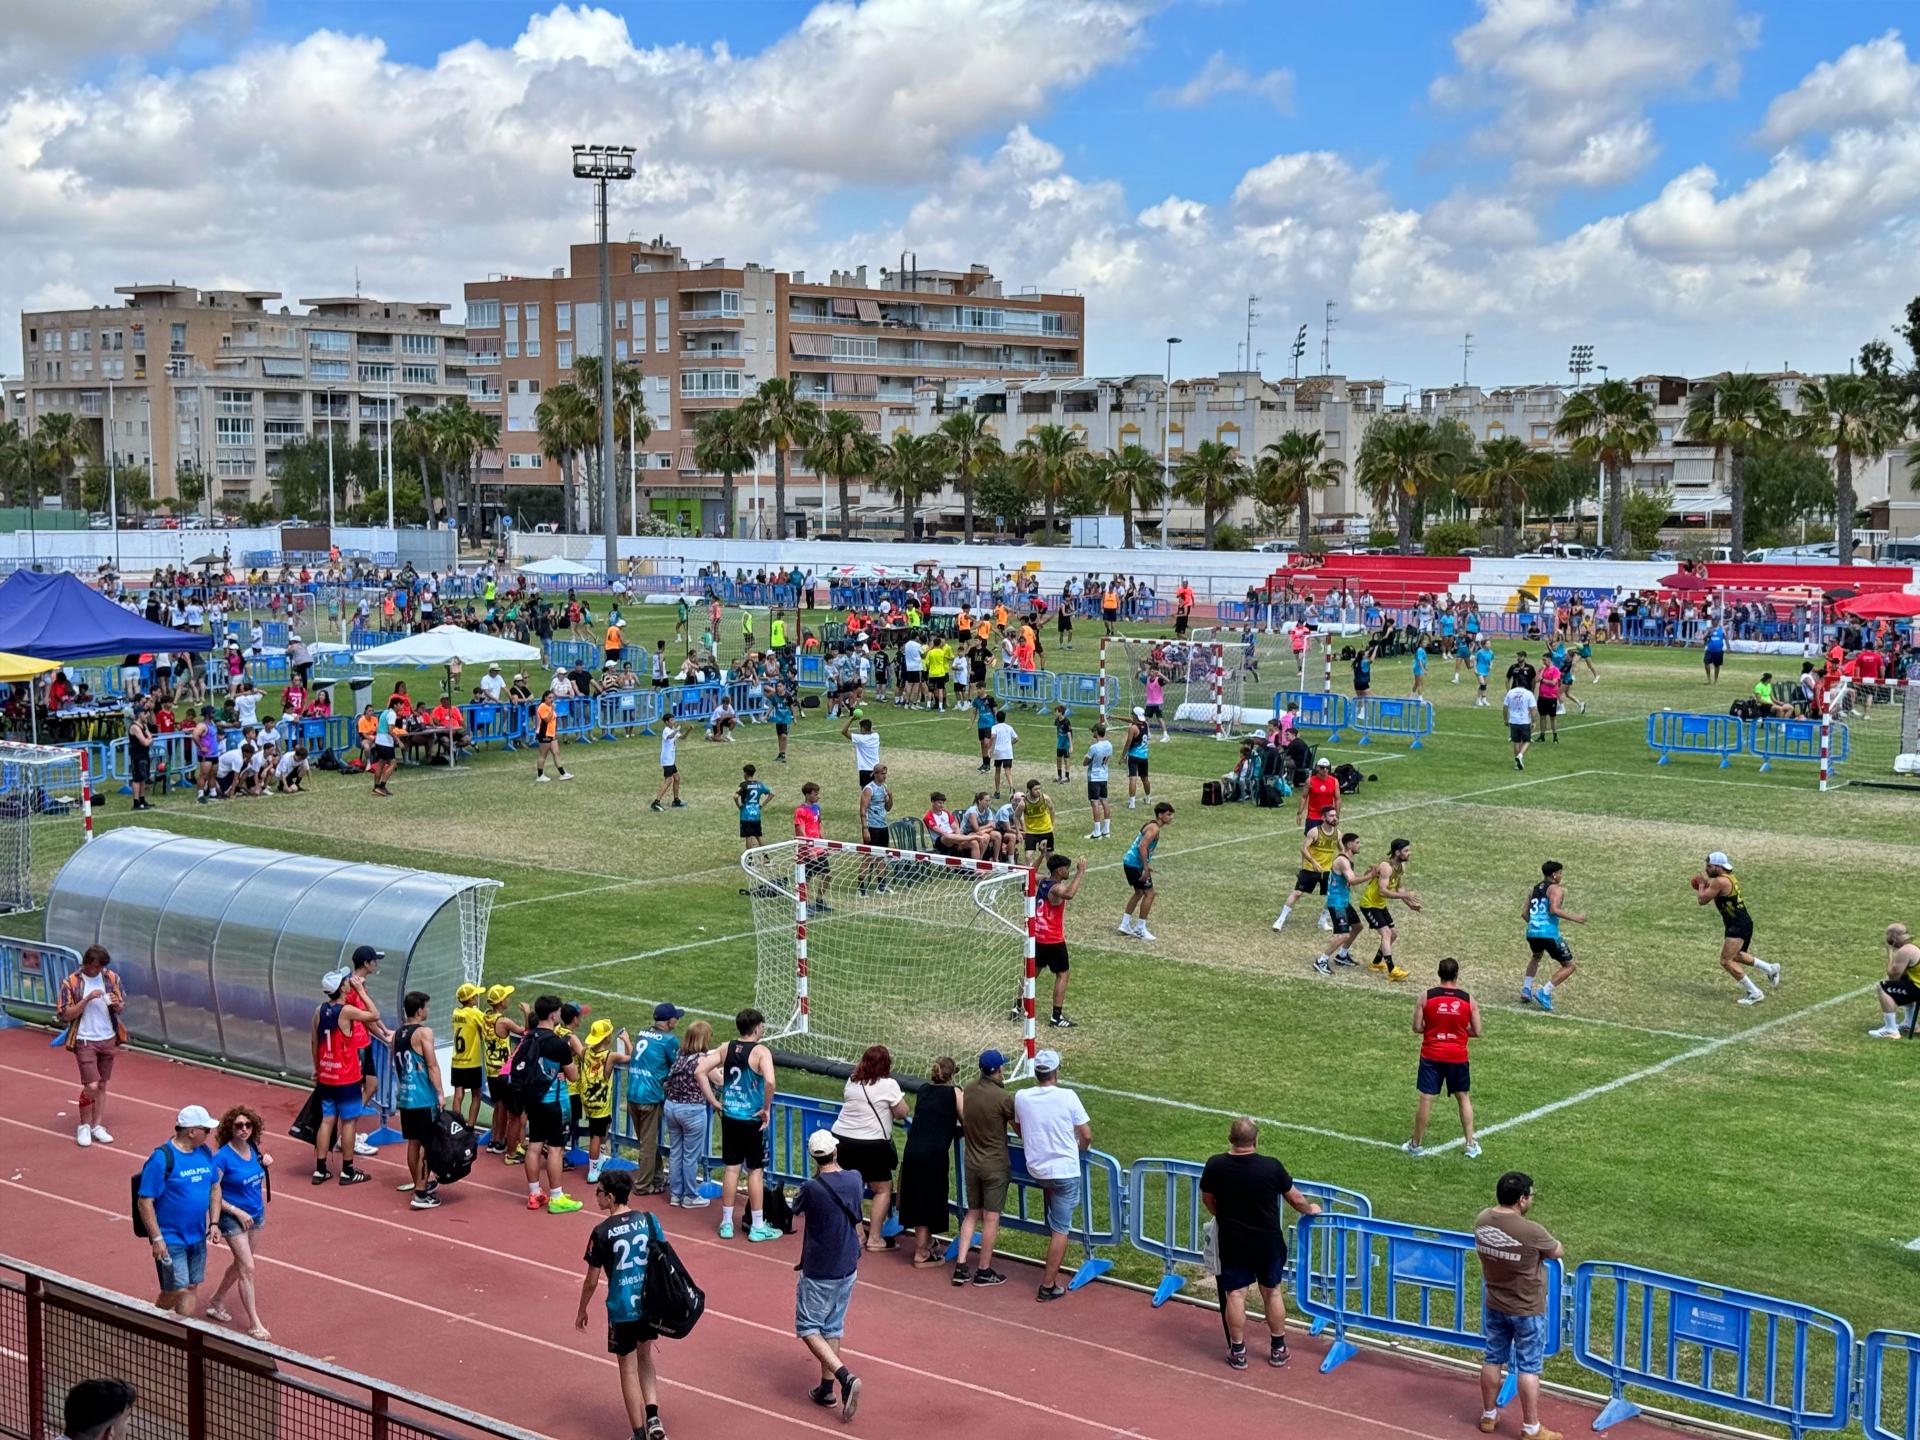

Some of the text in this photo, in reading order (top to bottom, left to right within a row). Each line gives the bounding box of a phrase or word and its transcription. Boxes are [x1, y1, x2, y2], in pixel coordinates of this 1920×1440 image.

[1547, 589, 1572, 600] SANTA
[748, 789, 758, 803] 2
[1529, 897, 1546, 915] 35
[323, 1029, 332, 1052] 1
[454, 1027, 466, 1054] 6
[635, 1039, 649, 1061] 9
[396, 1050, 413, 1074] 18
[729, 1066, 743, 1091] 2
[180, 1168, 197, 1178] SANTA
[607, 1223, 631, 1240] ASIER
[613, 1233, 650, 1271] 23
